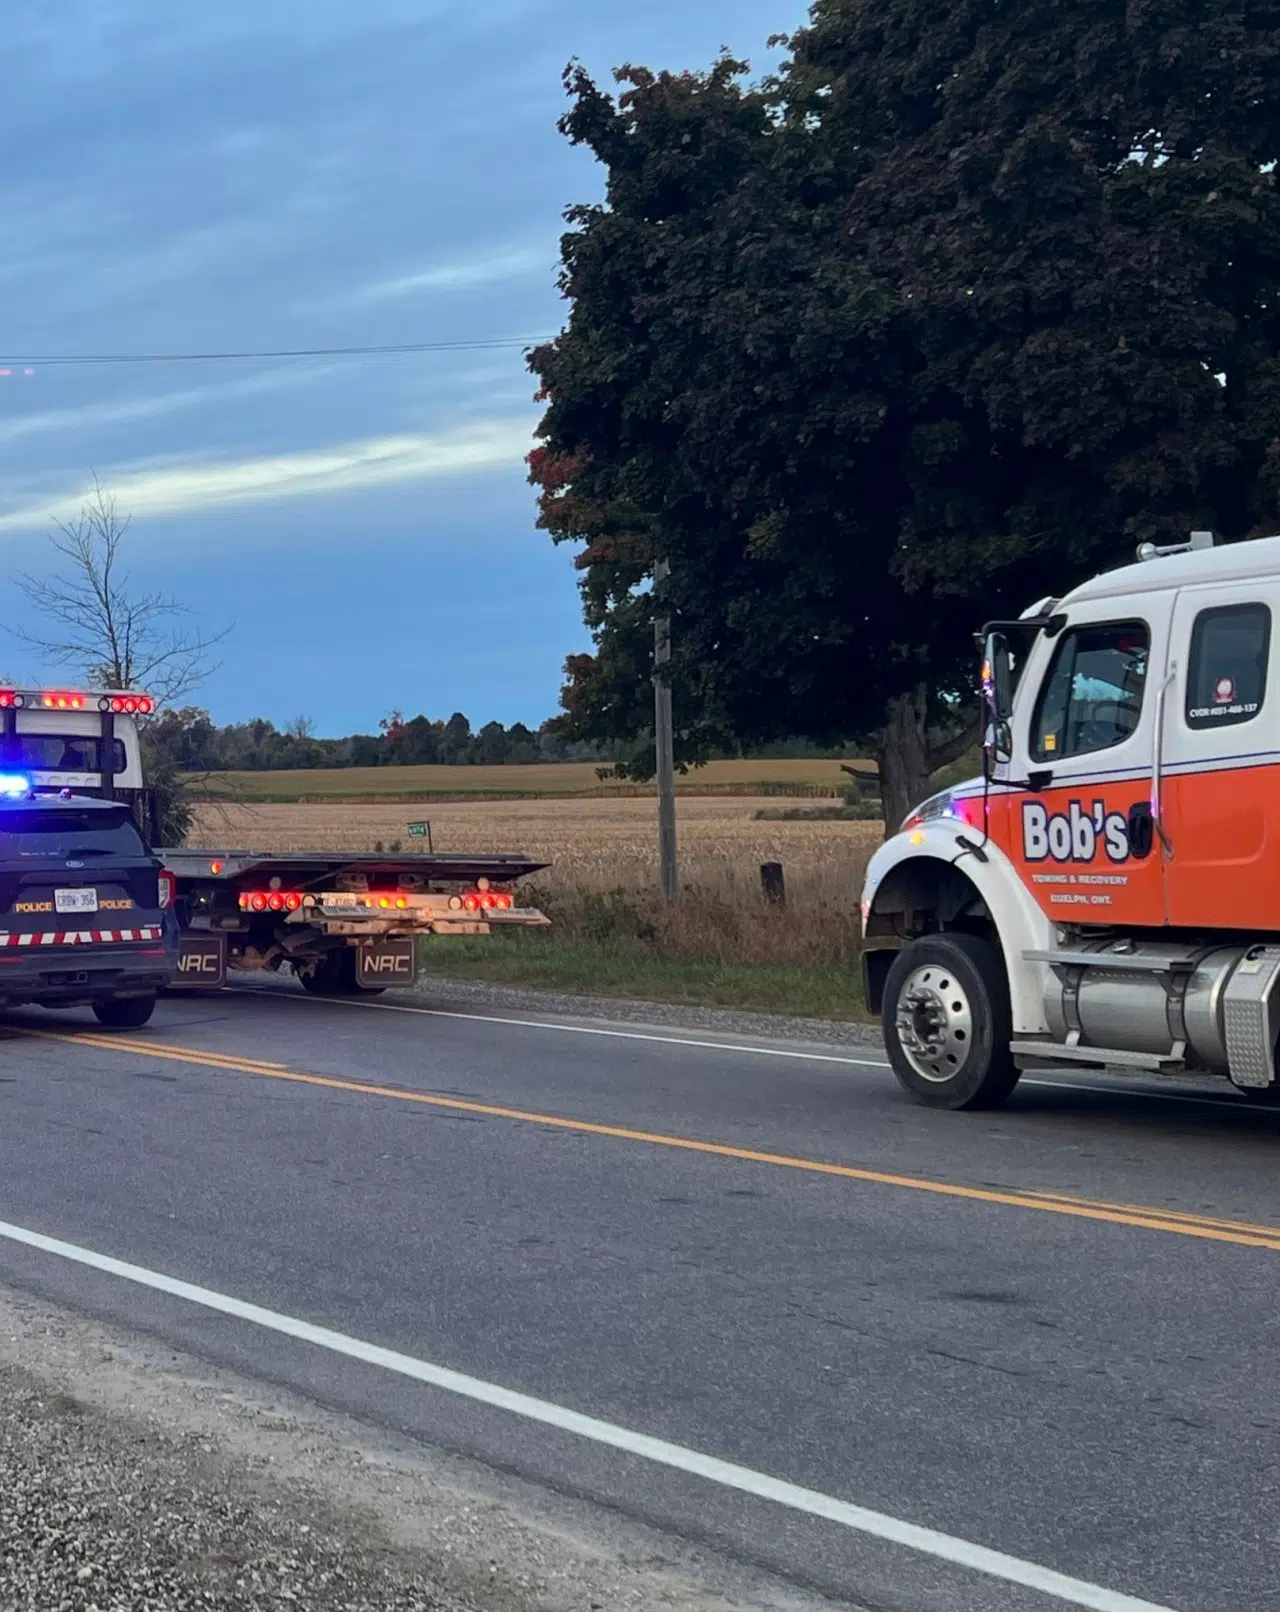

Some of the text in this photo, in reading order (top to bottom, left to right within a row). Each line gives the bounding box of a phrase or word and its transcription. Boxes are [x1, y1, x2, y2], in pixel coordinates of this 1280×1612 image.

[1021, 798, 1129, 863] Bob's
[1031, 874, 1128, 885] TOWING & RECOVERY
[15, 901, 53, 912] POLICE
[99, 899, 133, 909] POLICE
[364, 955, 410, 972] NRC
